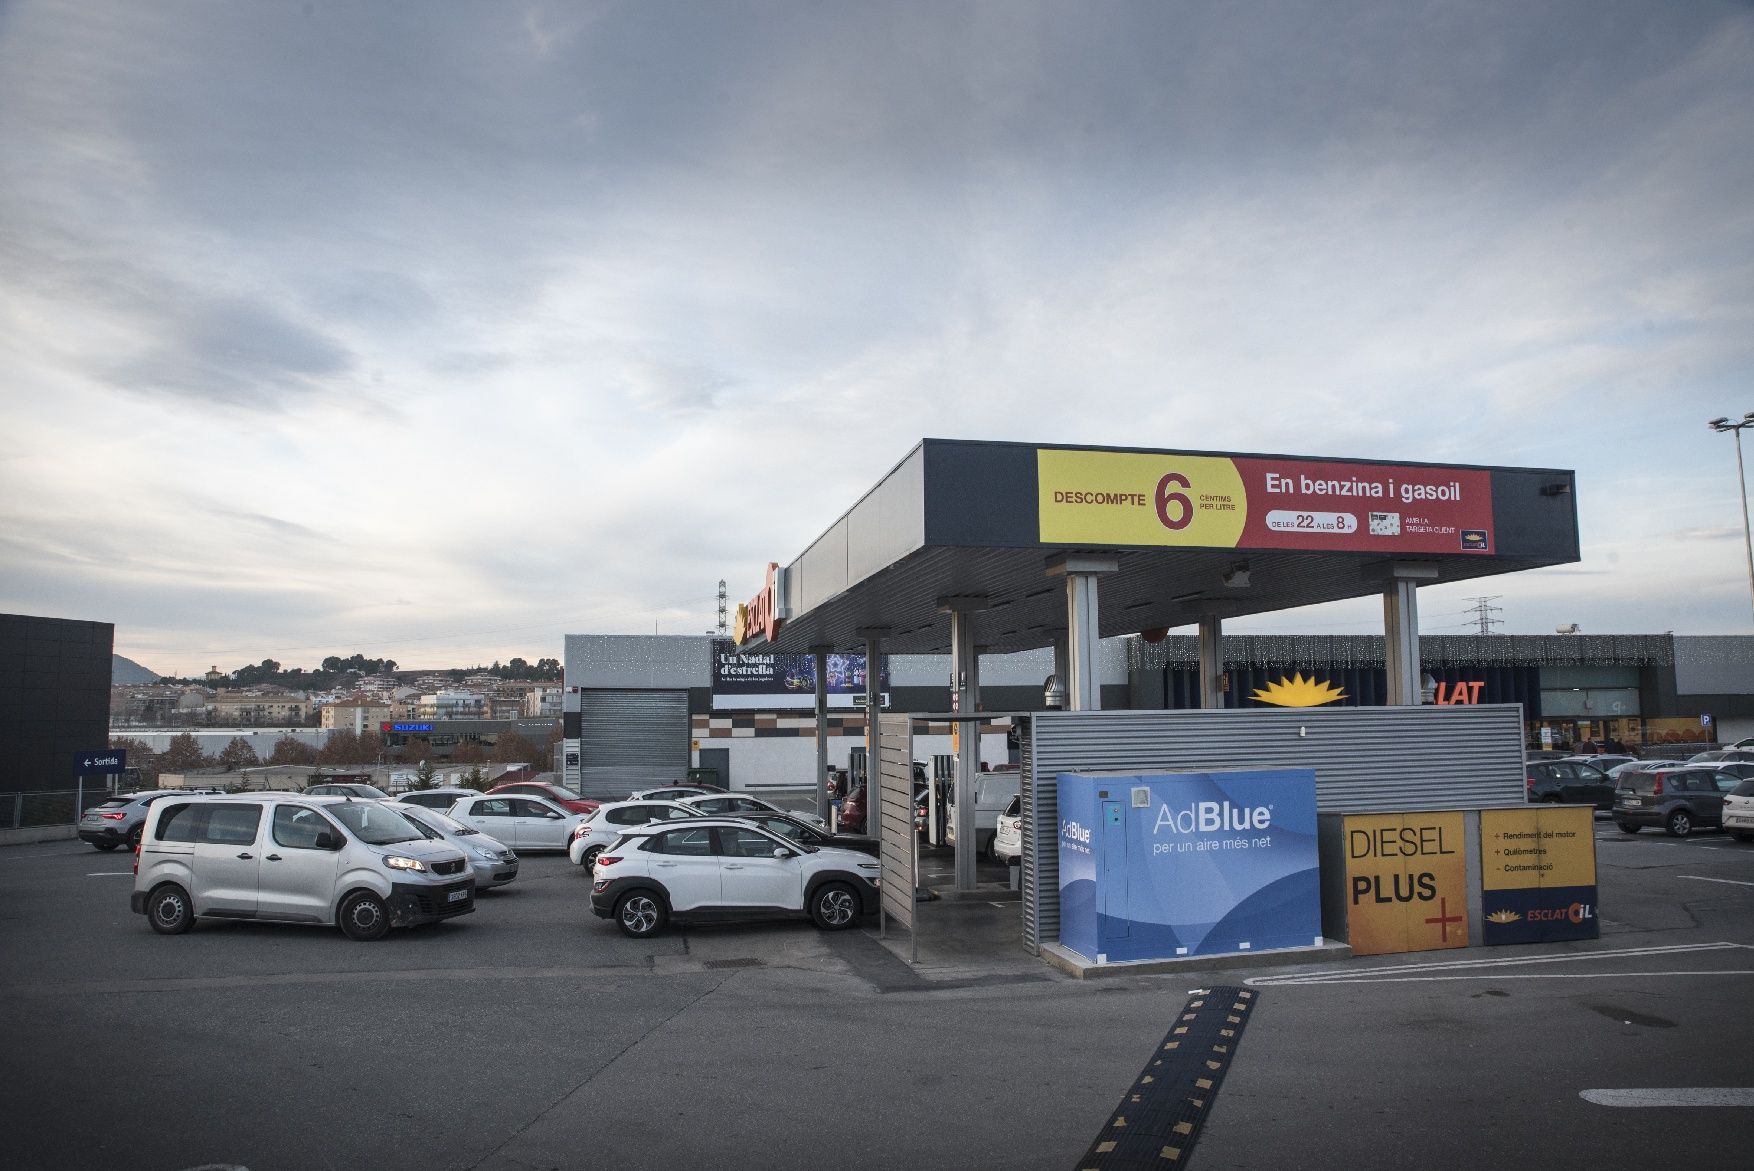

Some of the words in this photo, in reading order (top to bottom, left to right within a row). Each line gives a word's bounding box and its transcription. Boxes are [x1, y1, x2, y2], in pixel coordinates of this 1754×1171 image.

[1265, 472, 1294, 494] En
[1300, 474, 1383, 498] benzina
[1388, 478, 1395, 498] i
[1400, 481, 1460, 503] gasoil
[1054, 491, 1146, 506] DESCOMPTE
[1154, 472, 1194, 531] 6
[1199, 503, 1214, 511] PER
[1215, 503, 1236, 511] LITRE
[1296, 514, 1315, 529] 22
[1322, 521, 1335, 529] LES
[1336, 516, 1346, 530] 8
[1405, 517, 1420, 525] AMB
[1405, 525, 1433, 533] TARGETA
[1433, 526, 1456, 534] CLIENT
[720, 653, 737, 664] Un
[739, 653, 775, 664] Nadal
[94, 757, 118, 766] Sortida
[1503, 831, 1541, 840] Rendiment
[1542, 831, 1554, 839] del
[1153, 842, 1175, 856] per
[1177, 841, 1193, 852] un
[1196, 837, 1219, 851] aire
[1223, 836, 1249, 849] més
[1252, 835, 1271, 848] net
[1350, 826, 1456, 859] DIESEL
[1503, 863, 1554, 872] Contaminació
[1352, 872, 1437, 905] PLUS
